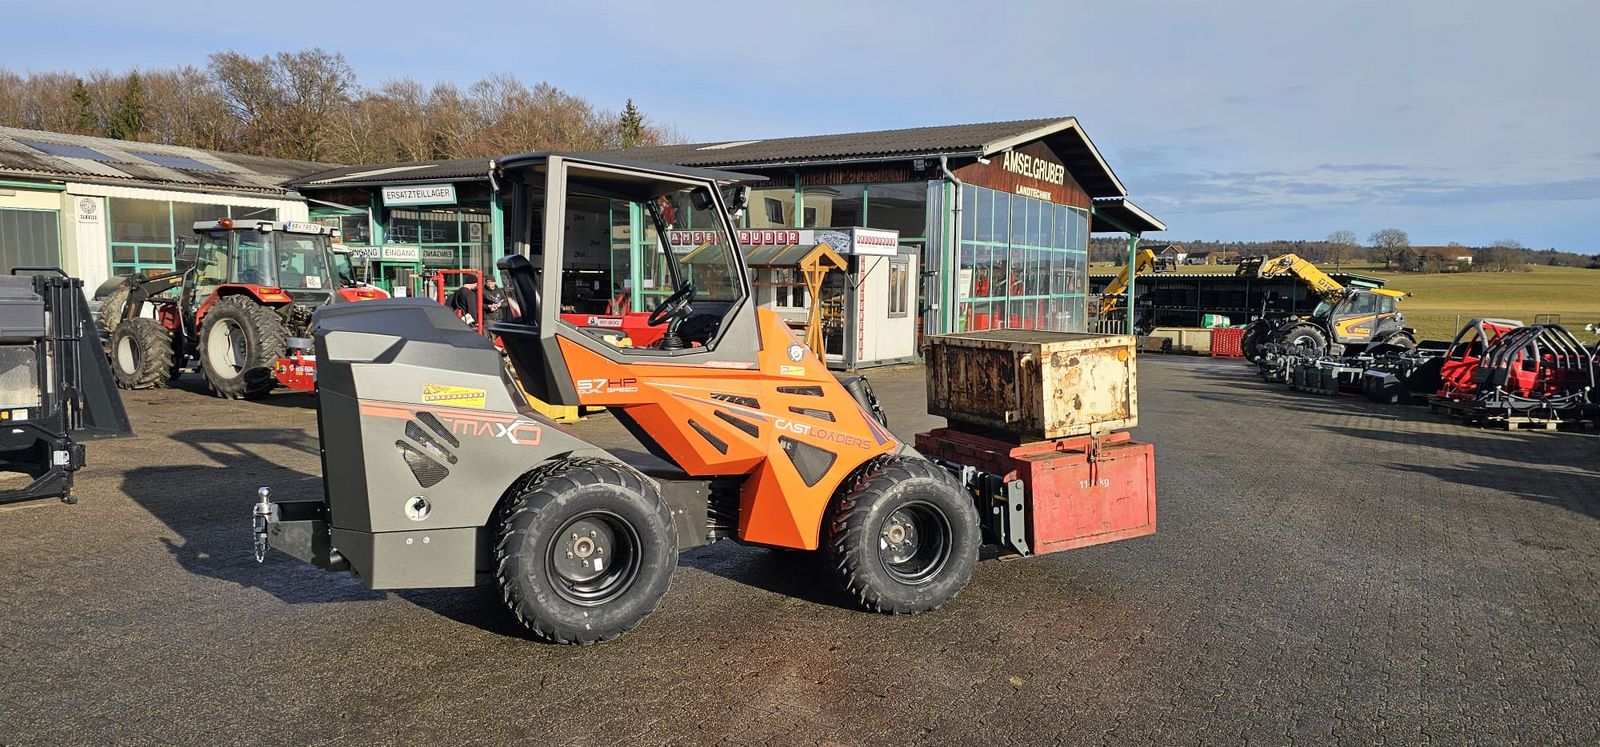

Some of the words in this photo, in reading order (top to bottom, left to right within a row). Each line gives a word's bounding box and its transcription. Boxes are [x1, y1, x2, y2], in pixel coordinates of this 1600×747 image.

[1003, 150, 1065, 186] AMSELGRUBER
[386, 188, 450, 200] ERSATZTEILLAGER
[1015, 184, 1052, 201] LANDTECHNIK
[671, 231, 800, 245] AMSERUBER
[385, 248, 416, 257] EINGANG
[1099, 477, 1110, 488] kg
